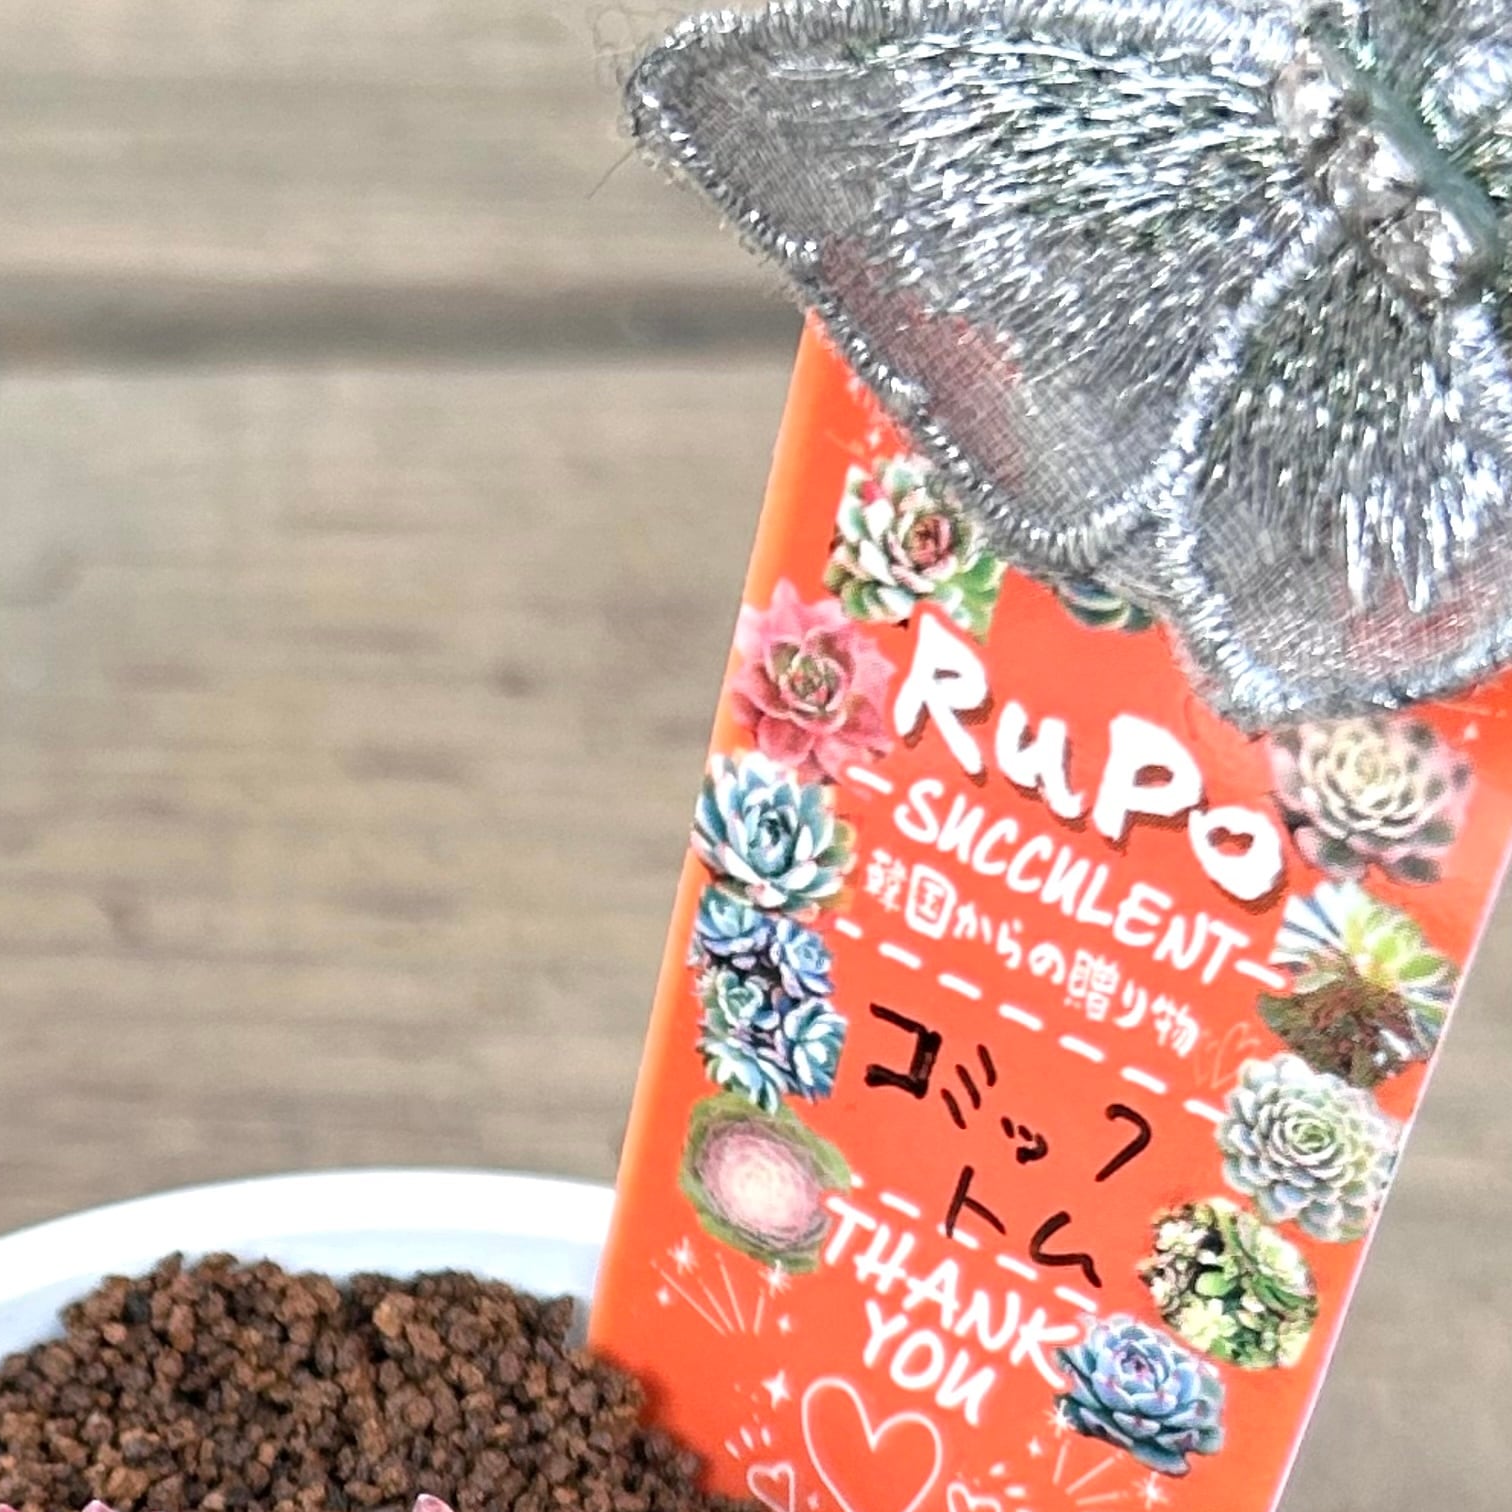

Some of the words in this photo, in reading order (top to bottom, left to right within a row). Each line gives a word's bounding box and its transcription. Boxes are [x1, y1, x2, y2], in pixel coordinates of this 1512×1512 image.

[865, 848, 1201, 1058] 韓国からの贈り物
[825, 1197, 1080, 1389] THANK
[863, 1300, 997, 1426] YOU
